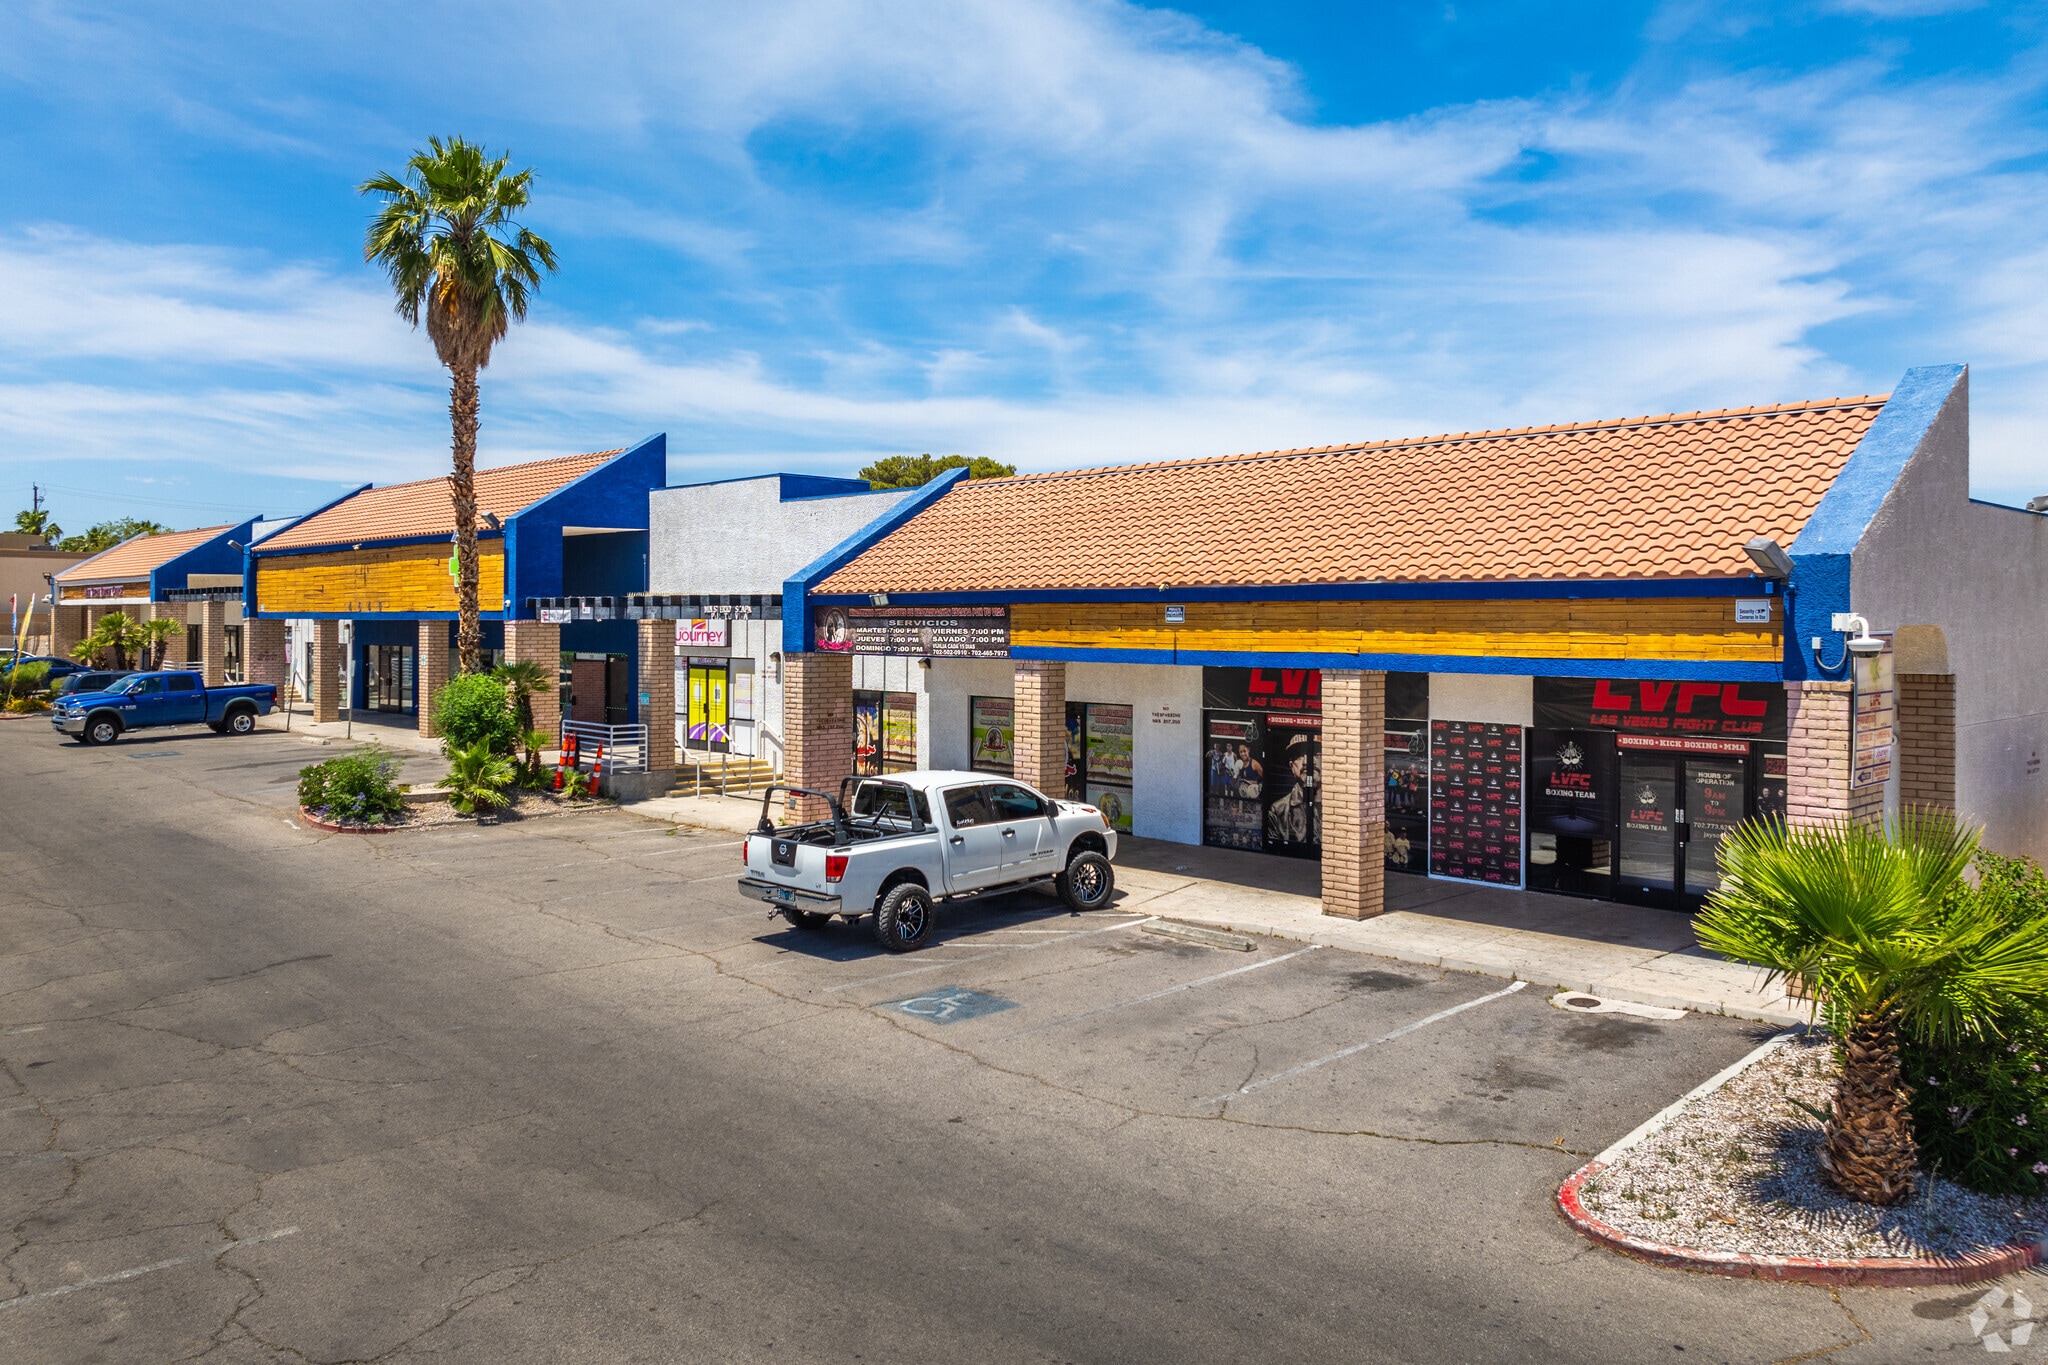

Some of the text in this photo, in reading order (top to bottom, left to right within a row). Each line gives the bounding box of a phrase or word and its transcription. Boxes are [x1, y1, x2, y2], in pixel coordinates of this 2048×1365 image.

[1248, 697, 1267, 706] LAS
[1270, 698, 1302, 708] VEGAS
[1590, 714, 1763, 733] LAS VEGAS FIGHT CLUB
[1623, 737, 1746, 751] BOXING KICK BOXING MMA
[1551, 772, 1591, 786] LVFC
[1696, 778, 1735, 786] OPERATION
[1546, 788, 1596, 799] BOXING TEAM
[1631, 810, 1664, 821] LVFC
[750, 870, 765, 878] TITAN
